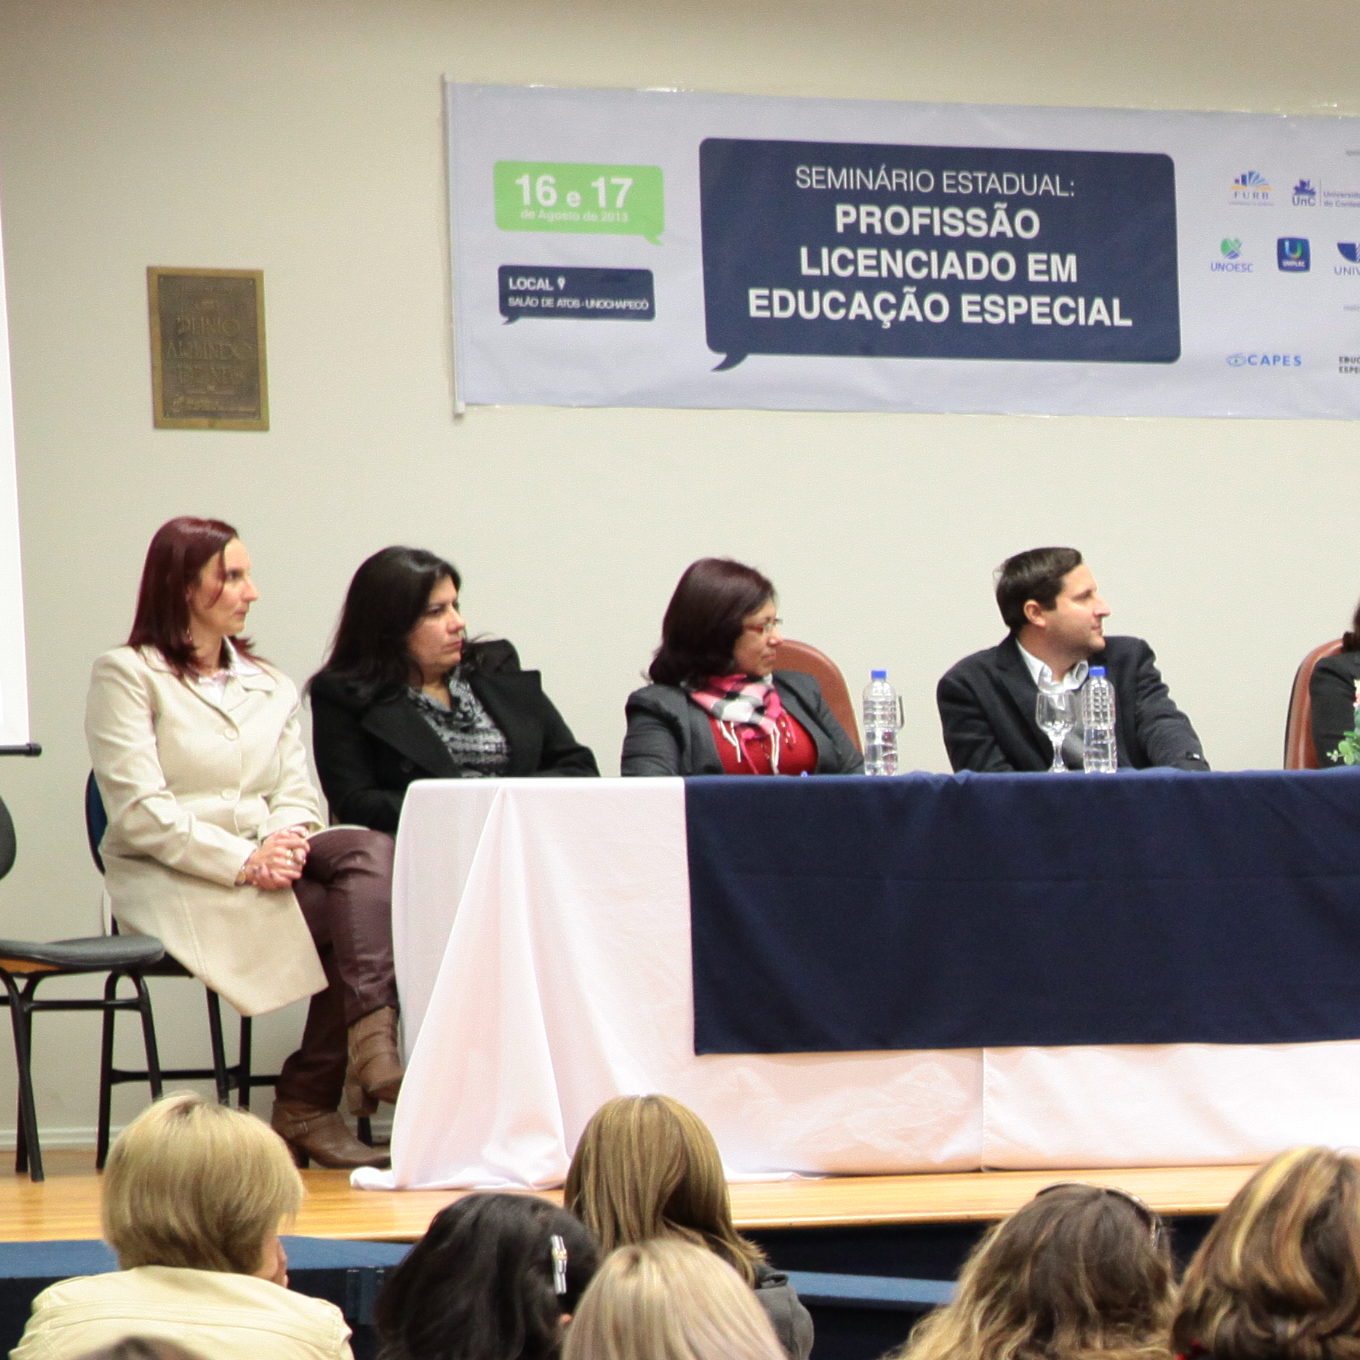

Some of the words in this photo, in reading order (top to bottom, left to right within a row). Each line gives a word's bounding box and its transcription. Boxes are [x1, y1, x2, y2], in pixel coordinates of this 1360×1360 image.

[795, 164, 935, 192] SEMINÁRIO
[942, 170, 1075, 197] ESTADUAL:
[515, 174, 558, 207] 16
[566, 190, 581, 208] e
[591, 176, 634, 208] 17
[1292, 195, 1316, 207] UnC
[520, 210, 535, 219] de
[538, 210, 580, 222] Agosto
[583, 211, 598, 221] de
[602, 212, 628, 222] 2013
[835, 202, 1041, 240] PROFISSÃO
[800, 247, 1016, 281] LICENCIADO
[1027, 253, 1078, 282] EM
[1210, 262, 1253, 273] UNOESC
[509, 277, 554, 291] LOCAL
[508, 296, 539, 308] SALÃO
[541, 298, 554, 308] DE
[556, 298, 580, 309] ATOS
[748, 286, 949, 328] EDUCAÇÃO
[961, 296, 1133, 327] ESPECIAL
[1247, 354, 1302, 367] CAPES
